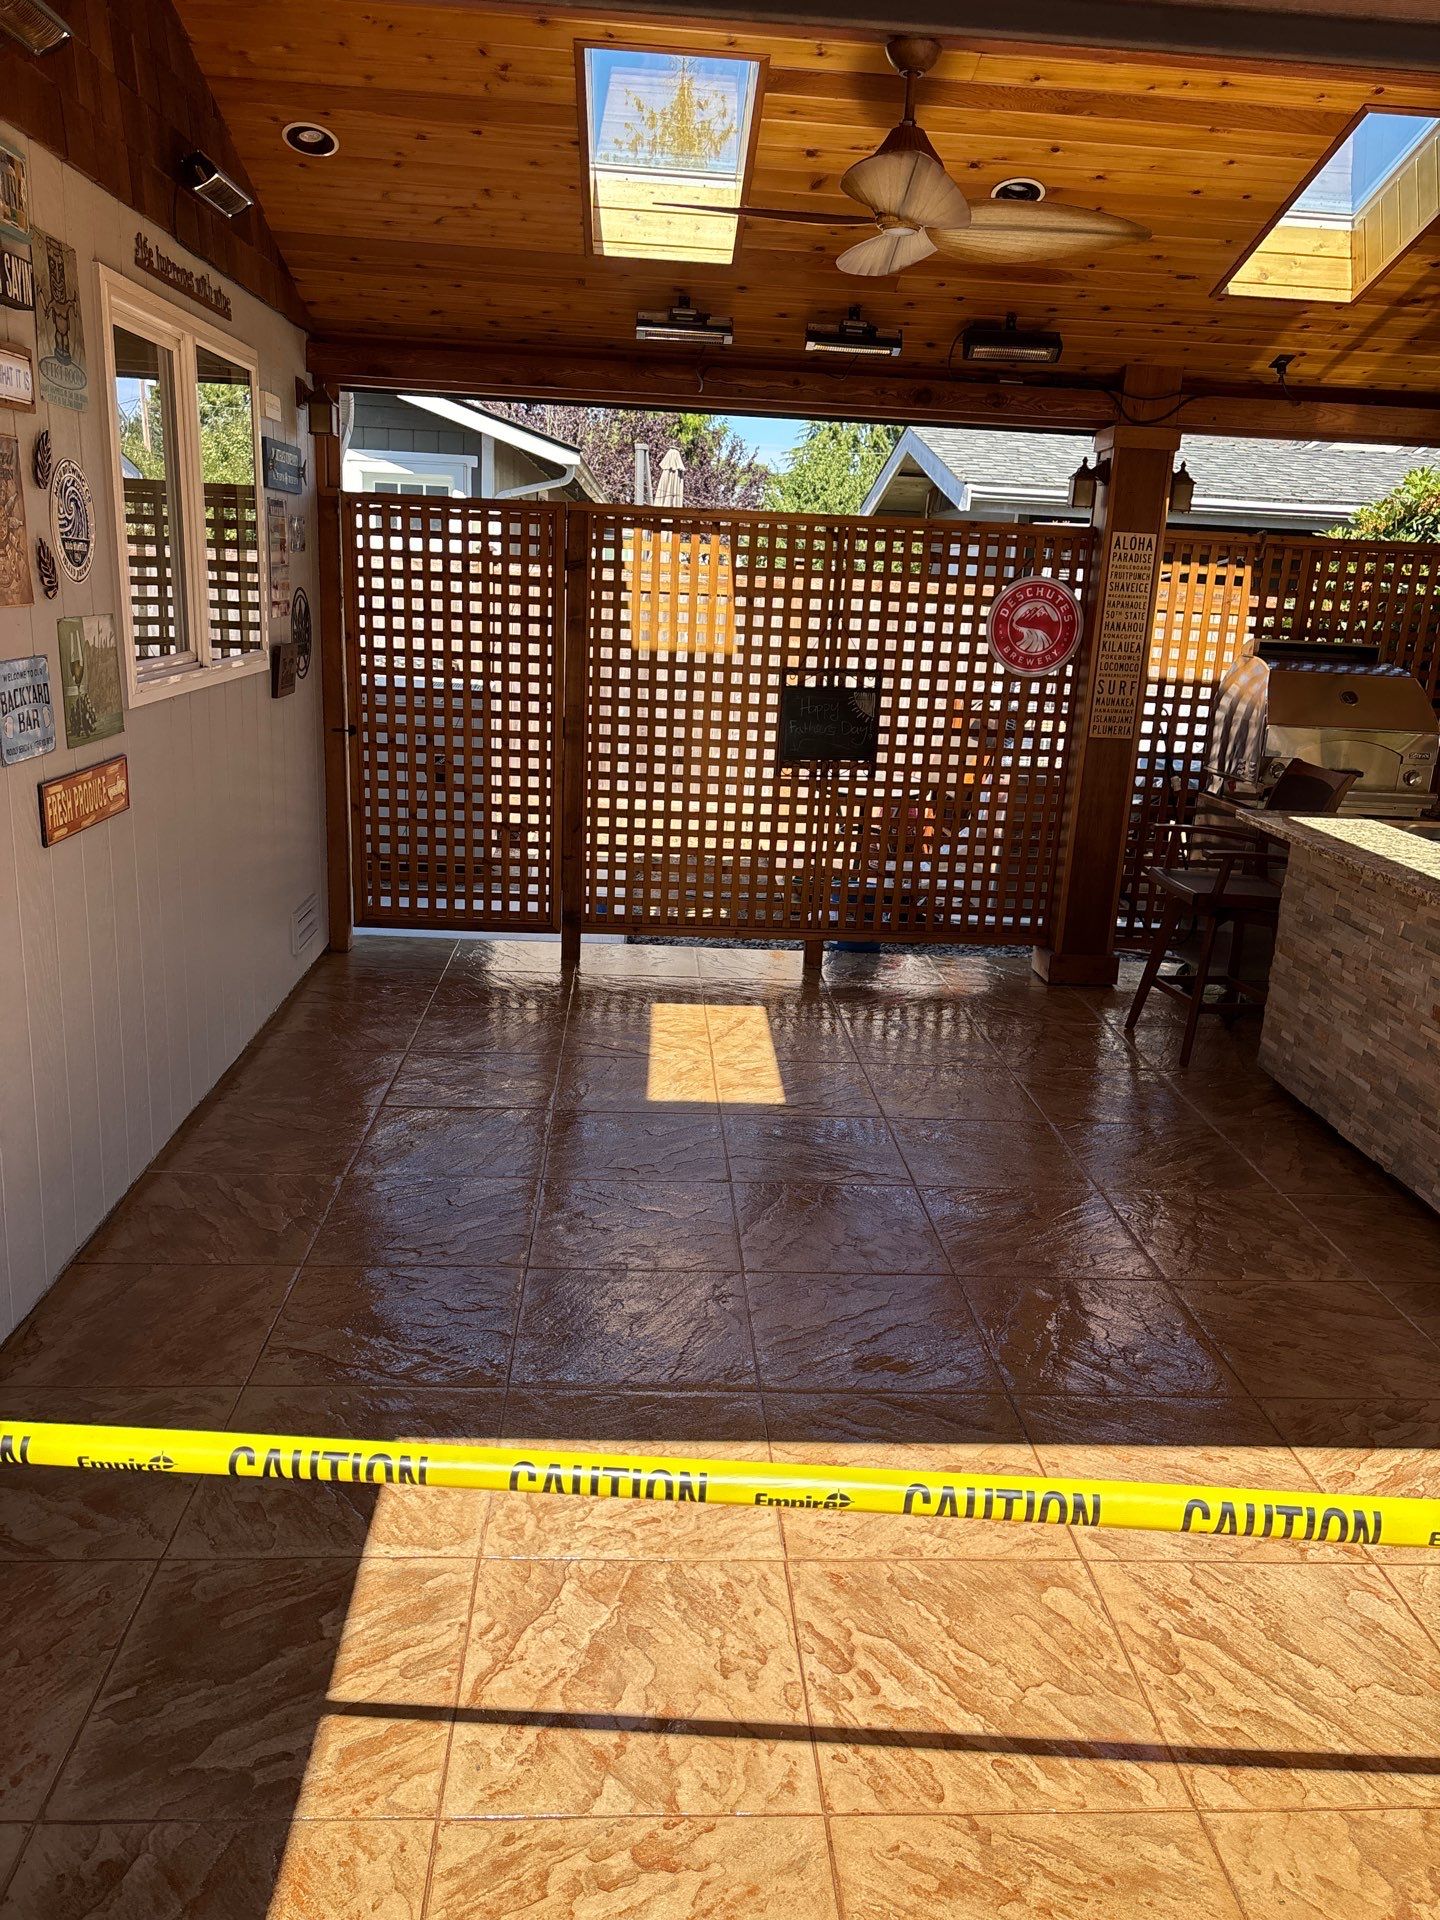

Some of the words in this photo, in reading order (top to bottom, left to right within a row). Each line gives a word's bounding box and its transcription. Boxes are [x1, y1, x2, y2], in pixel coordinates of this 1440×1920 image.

[1114, 536, 1153, 551] ALOHA
[1112, 552, 1152, 563] PARADISE
[1110, 571, 1151, 580] FRUITPUNCH
[1109, 582, 1149, 593] SHAVEICE
[1000, 586, 1073, 622] DESCHUTES
[1107, 600, 1147, 610] HAPAHAOLE
[1124, 611, 1146, 620] STATE
[1104, 621, 1145, 632] HANAHOU
[1101, 641, 1141, 653] KILAUEA
[1003, 645, 1059, 666] BREWERY
[1100, 662, 1139, 672] LOCOMOCO
[3, 671, 27, 683] WELCOME
[1097, 680, 1137, 695] SURF
[0, 683, 51, 717] BACKYARD
[1095, 697, 1135, 706] MAUNAKEA
[800, 695, 840, 721] Happy
[18, 708, 41, 733] BAR
[1093, 715, 1133, 723] ISLANDJAMZ
[1092, 724, 1131, 735] PLUMERIA
[46, 788, 74, 831] FRESH
[73, 775, 107, 819] PRODUCE
[228, 1446, 428, 1485] CAUTION
[509, 1461, 708, 1503] CAUTION
[902, 1483, 1101, 1527] CAUTION
[1180, 1499, 1382, 1545] CAUTION
